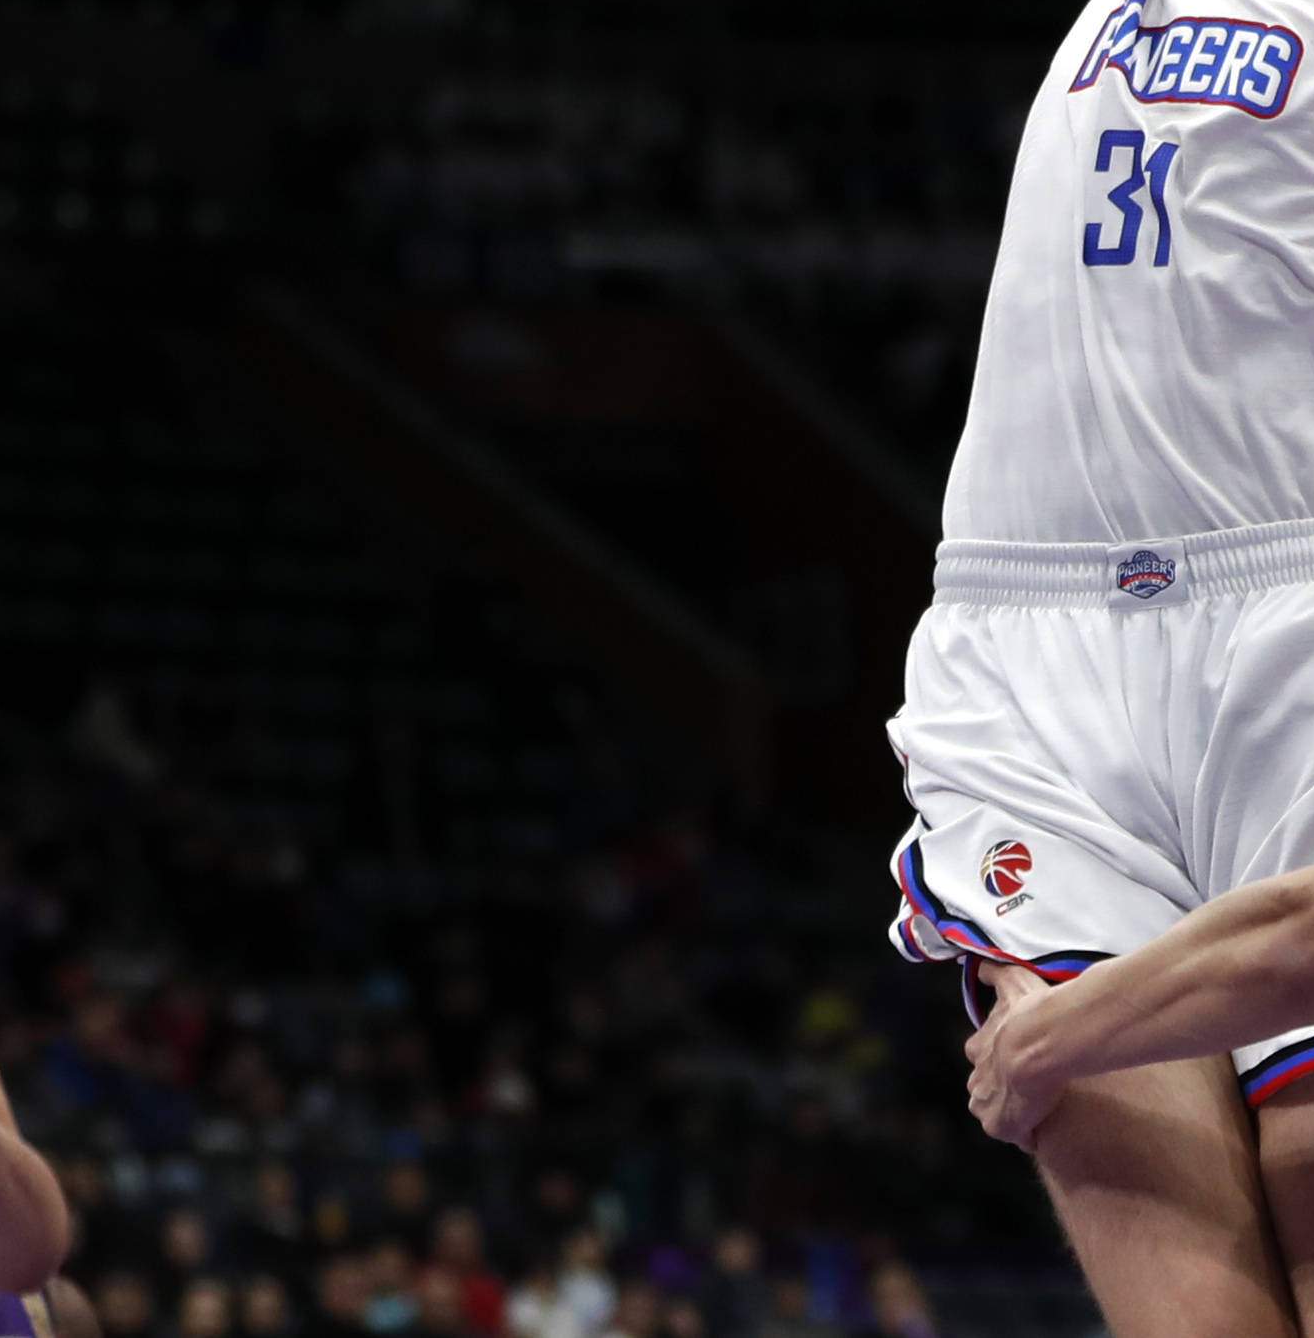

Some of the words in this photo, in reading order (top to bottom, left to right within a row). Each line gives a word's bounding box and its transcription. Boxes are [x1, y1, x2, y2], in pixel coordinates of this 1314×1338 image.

[1083, 129, 1179, 267] 31
[1118, 558, 1175, 586] PIONEERS
[996, 892, 1035, 918] CBA
